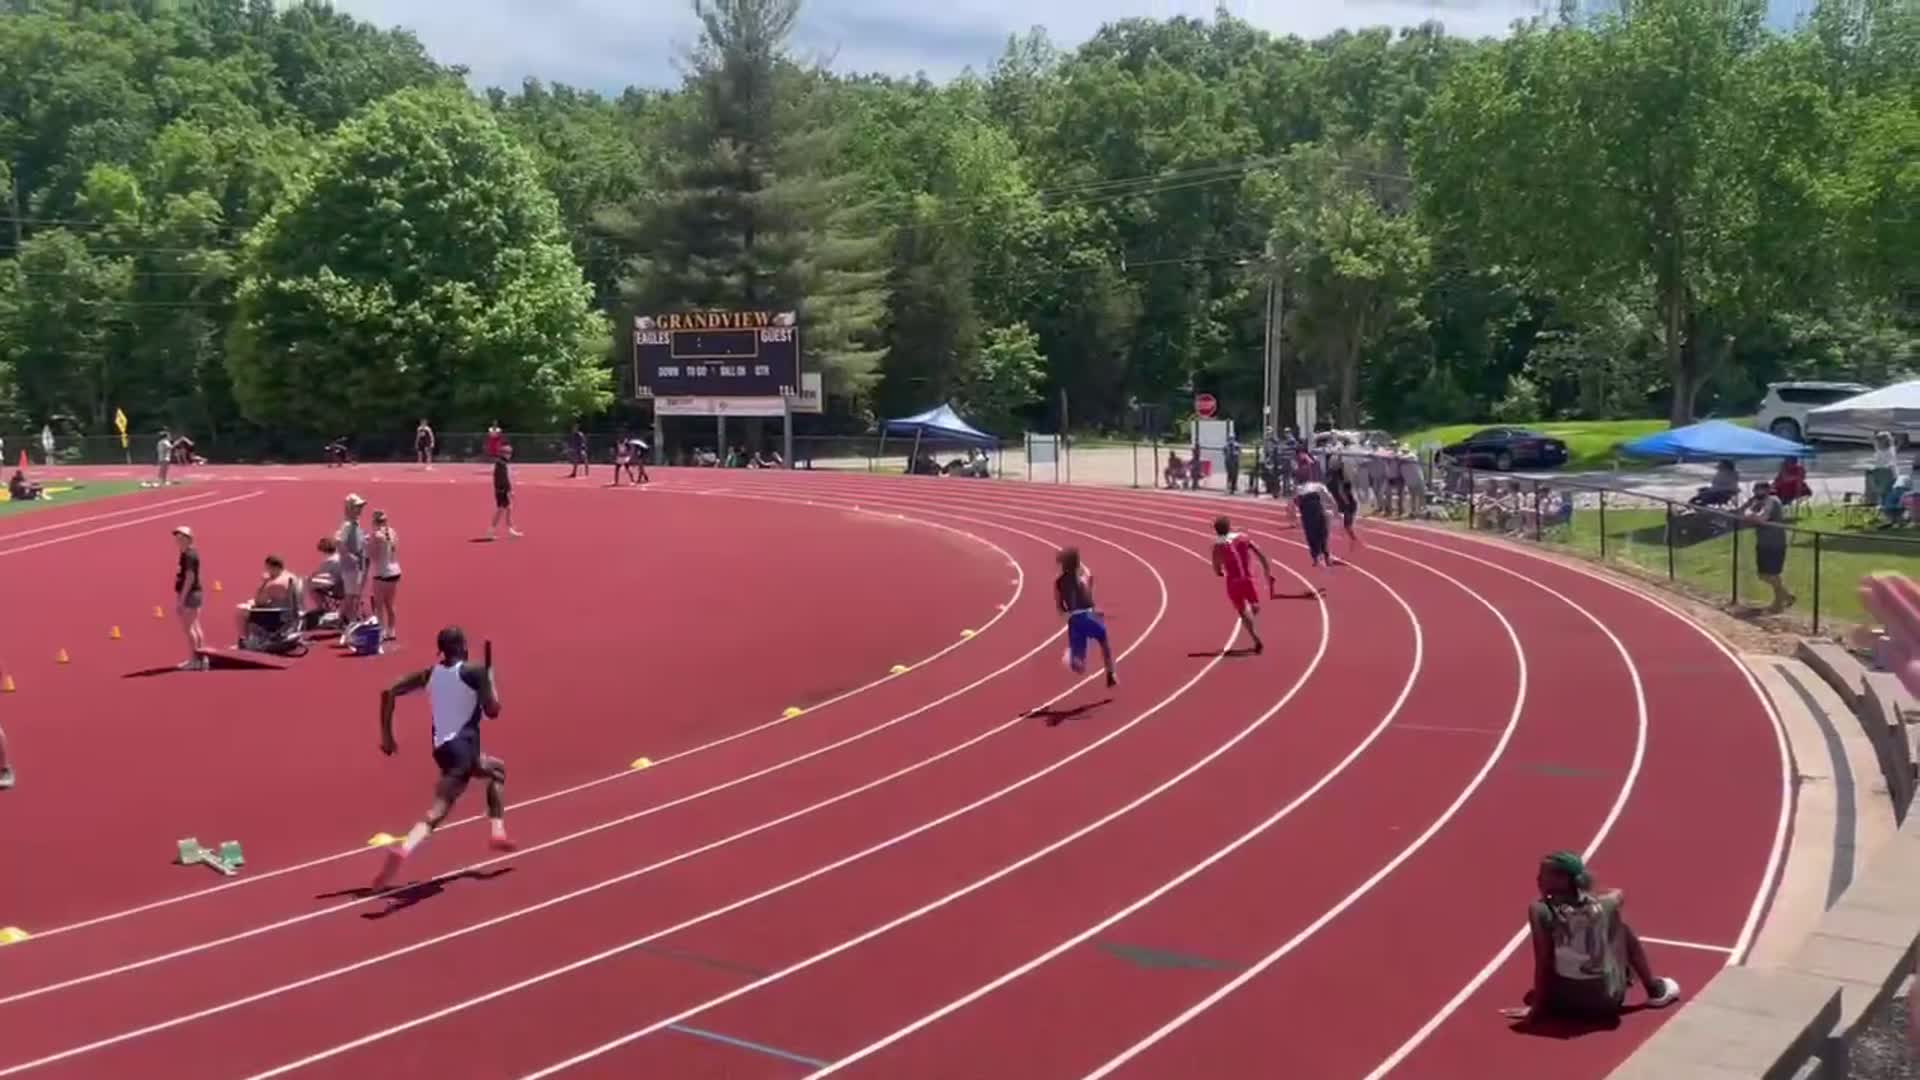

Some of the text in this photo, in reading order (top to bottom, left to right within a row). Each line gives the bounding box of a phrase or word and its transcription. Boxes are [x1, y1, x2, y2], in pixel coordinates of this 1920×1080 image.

[656, 311, 768, 329] GRANDVIEW
[635, 331, 670, 345] EAGLES
[760, 328, 793, 343] GUEST
